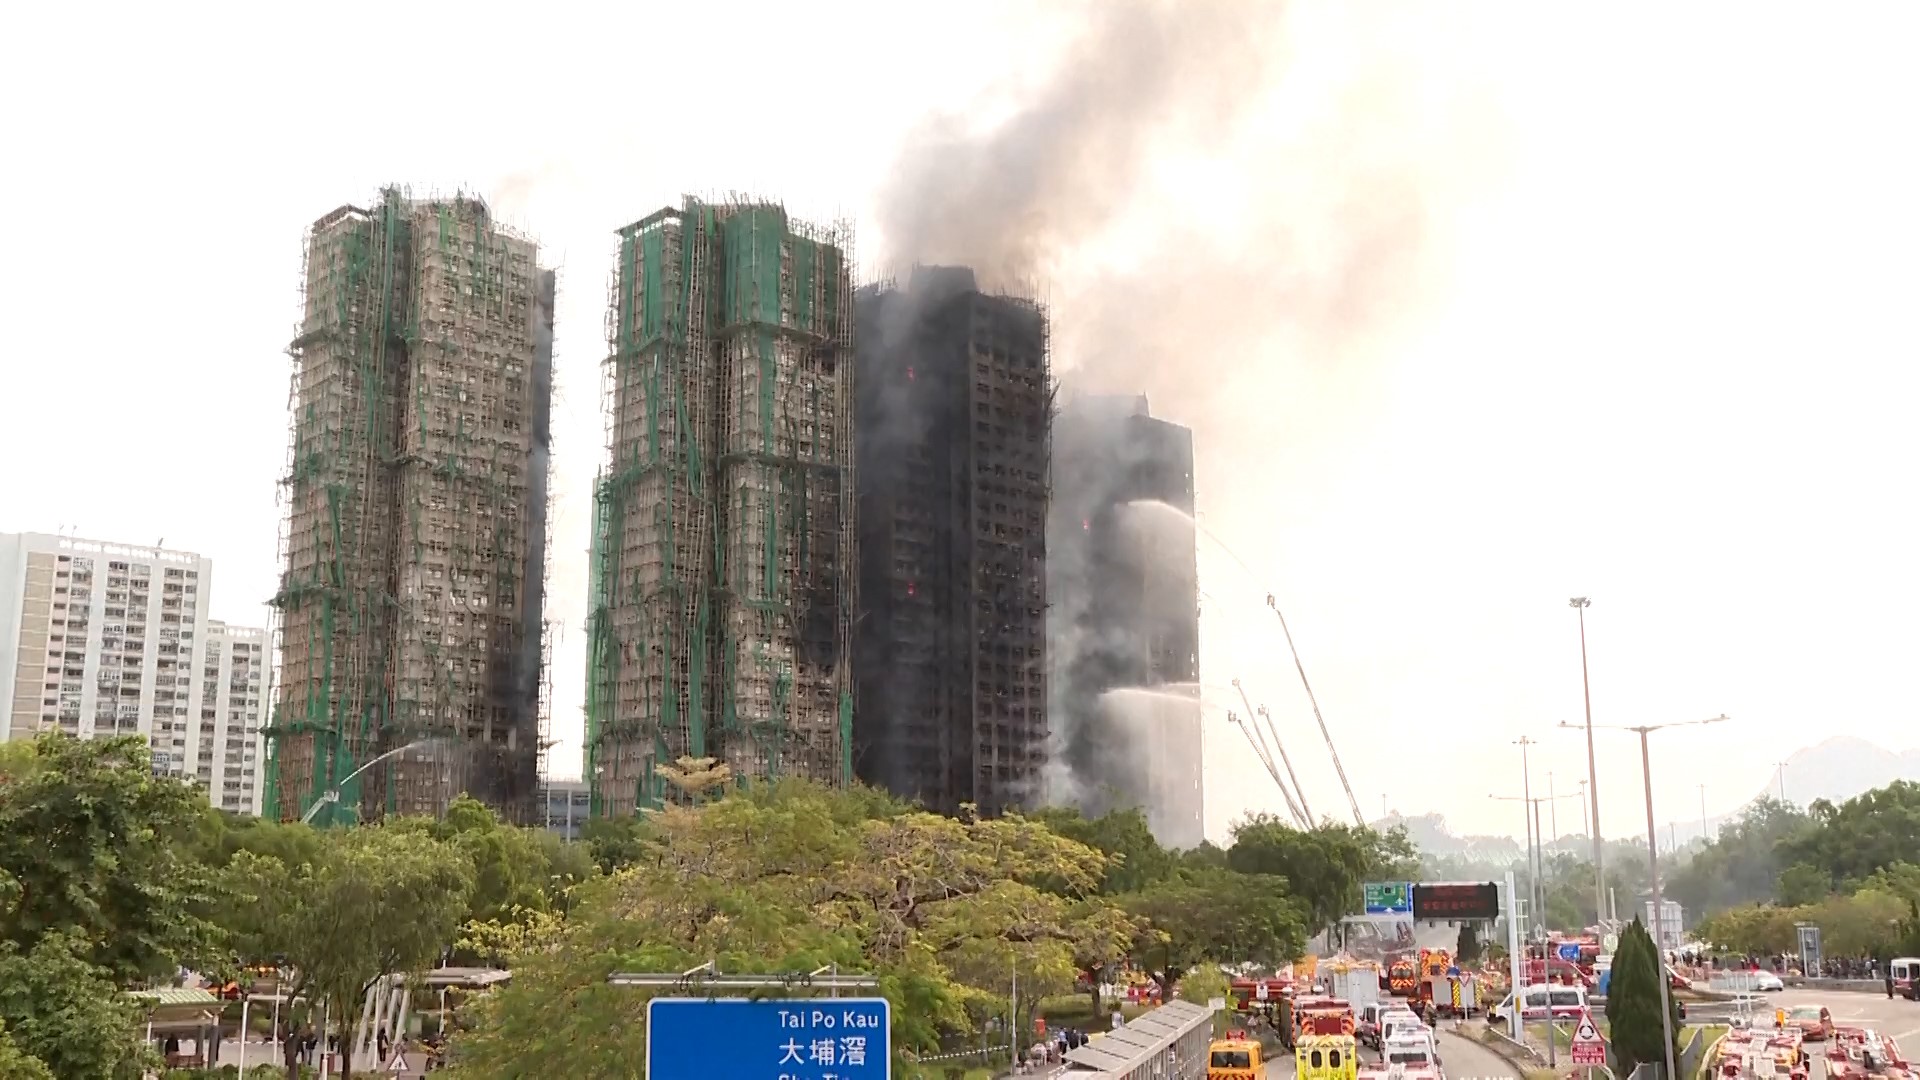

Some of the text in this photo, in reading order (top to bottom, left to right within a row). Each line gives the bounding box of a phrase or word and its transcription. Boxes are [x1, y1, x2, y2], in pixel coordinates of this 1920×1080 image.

[778, 1011, 879, 1028] Tai Po Kau
[778, 1037, 866, 1066] 大埔滘
